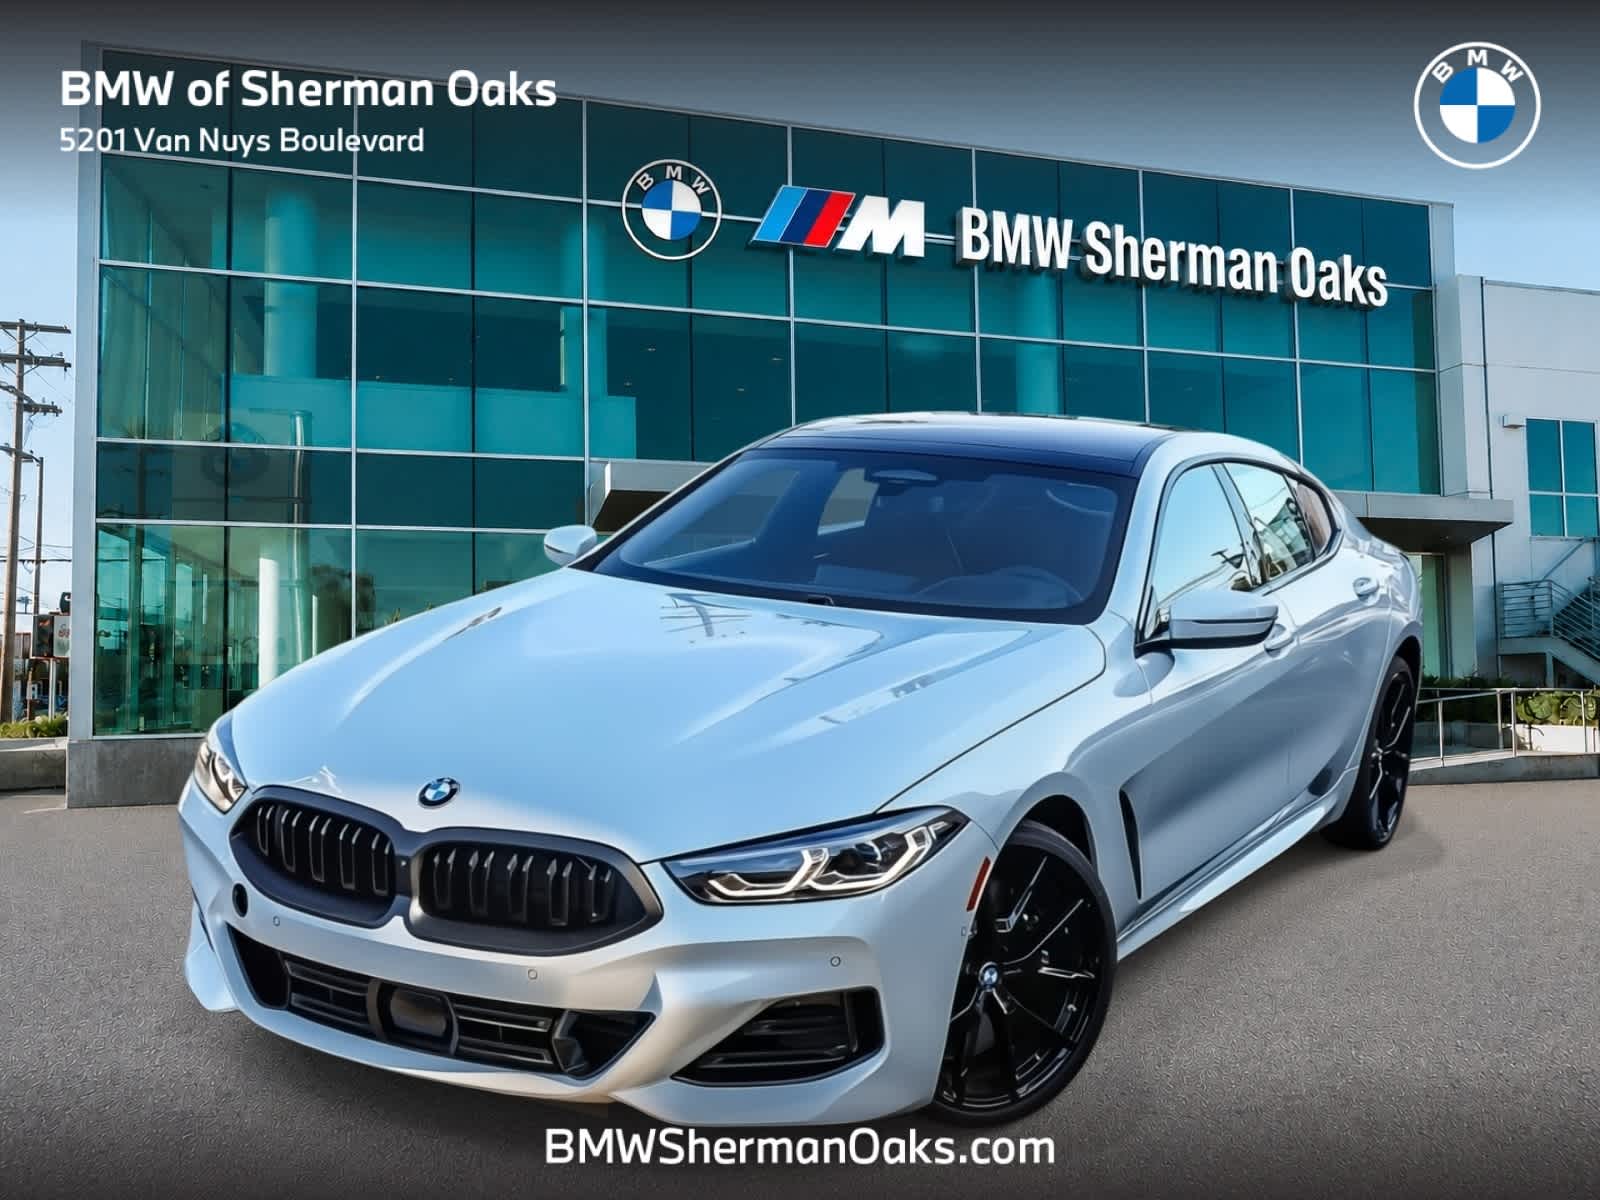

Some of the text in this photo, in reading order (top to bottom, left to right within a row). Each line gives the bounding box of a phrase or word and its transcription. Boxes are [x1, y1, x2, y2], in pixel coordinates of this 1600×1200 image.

[636, 165, 710, 195] BMW
[959, 206, 1388, 307] BMW Sherman Oaks
